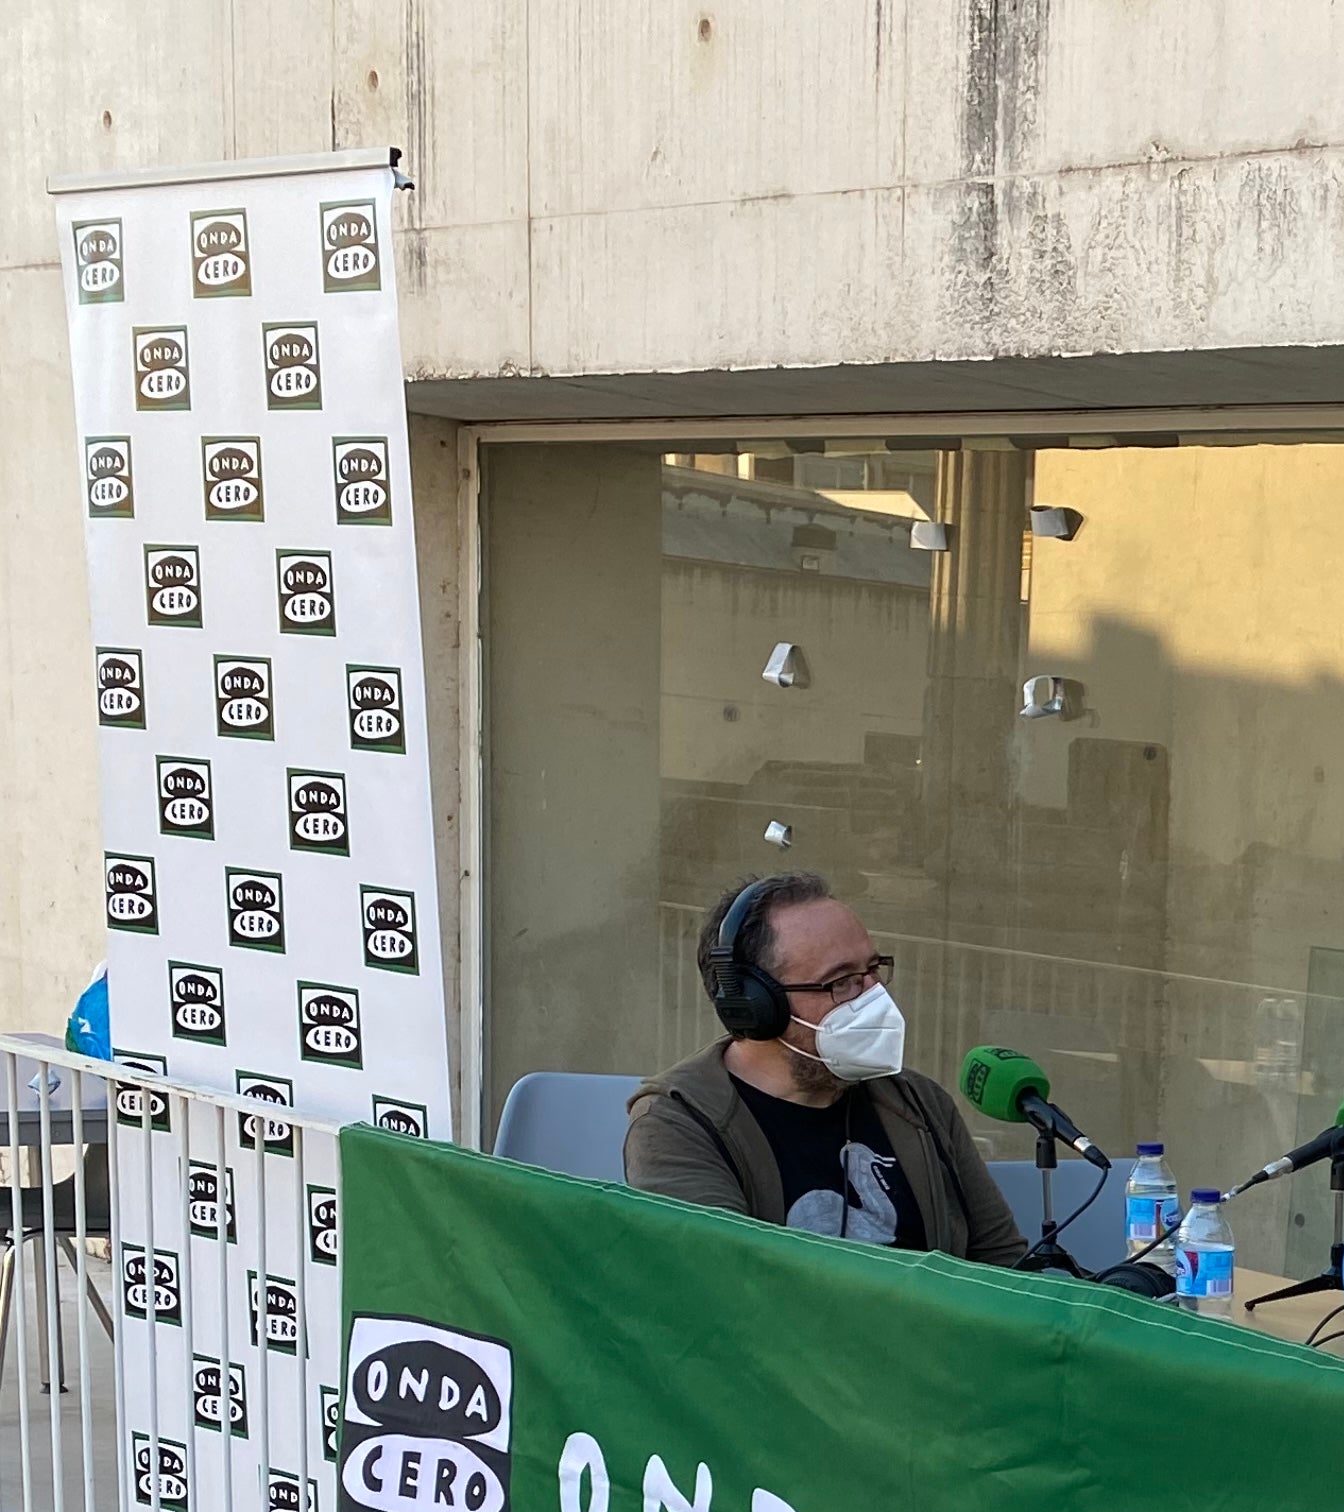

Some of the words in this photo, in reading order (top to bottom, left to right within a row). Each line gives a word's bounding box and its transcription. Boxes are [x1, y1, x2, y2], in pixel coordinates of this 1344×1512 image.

[330, 221, 369, 239] ONDA
[82, 239, 114, 253] ONDA
[200, 232, 238, 247] ONDA
[205, 260, 239, 278] CERO
[334, 253, 370, 271] CERO
[85, 267, 116, 285] CERO
[144, 347, 180, 362] ONDA
[272, 343, 310, 360] ONDA
[148, 376, 181, 392] CERO
[277, 374, 311, 391] CERO
[91, 456, 121, 470] ONDA
[212, 457, 249, 472] ONDA
[341, 458, 378, 475] ONDA
[95, 483, 122, 499] CERO
[217, 485, 250, 502] CERO
[345, 489, 379, 505] CERO
[155, 564, 191, 579] ONDA
[287, 570, 324, 585] ONDA
[160, 593, 192, 609] CERO
[291, 600, 325, 616] CERO
[100, 666, 131, 681] ONDA
[224, 675, 260, 691] ONDA
[103, 693, 133, 710] CERO
[355, 686, 391, 702] ONDA
[228, 704, 261, 721] CERO
[359, 716, 392, 733] CERO
[167, 777, 202, 792] ONDA
[300, 789, 337, 806] ONDA
[171, 805, 203, 821] CERO
[304, 819, 338, 836] CERO
[109, 872, 143, 887] ONDA
[236, 888, 272, 905] ONDA
[112, 899, 145, 915] CERO
[369, 907, 404, 925] ONDA
[239, 916, 273, 934] CERO
[373, 935, 406, 954] CERO
[179, 982, 214, 998] ONDA
[182, 1008, 215, 1026] CERO
[309, 1003, 349, 1020] ONDA
[314, 1031, 355, 1049] CERO
[121, 1094, 158, 1112] CEO
[250, 1119, 284, 1137] CRO
[381, 1117, 416, 1136] ONDA
[189, 1178, 222, 1195] OND
[192, 1204, 224, 1222] CER
[260, 1292, 295, 1310] NDA
[262, 1319, 296, 1337] ERO
[199, 1373, 235, 1392] ONA
[366, 1359, 488, 1423] ONDA
[203, 1398, 237, 1418] CEO
[141, 1452, 181, 1470] ODA
[362, 1444, 488, 1512] CERO
[270, 1487, 305, 1505] OND
